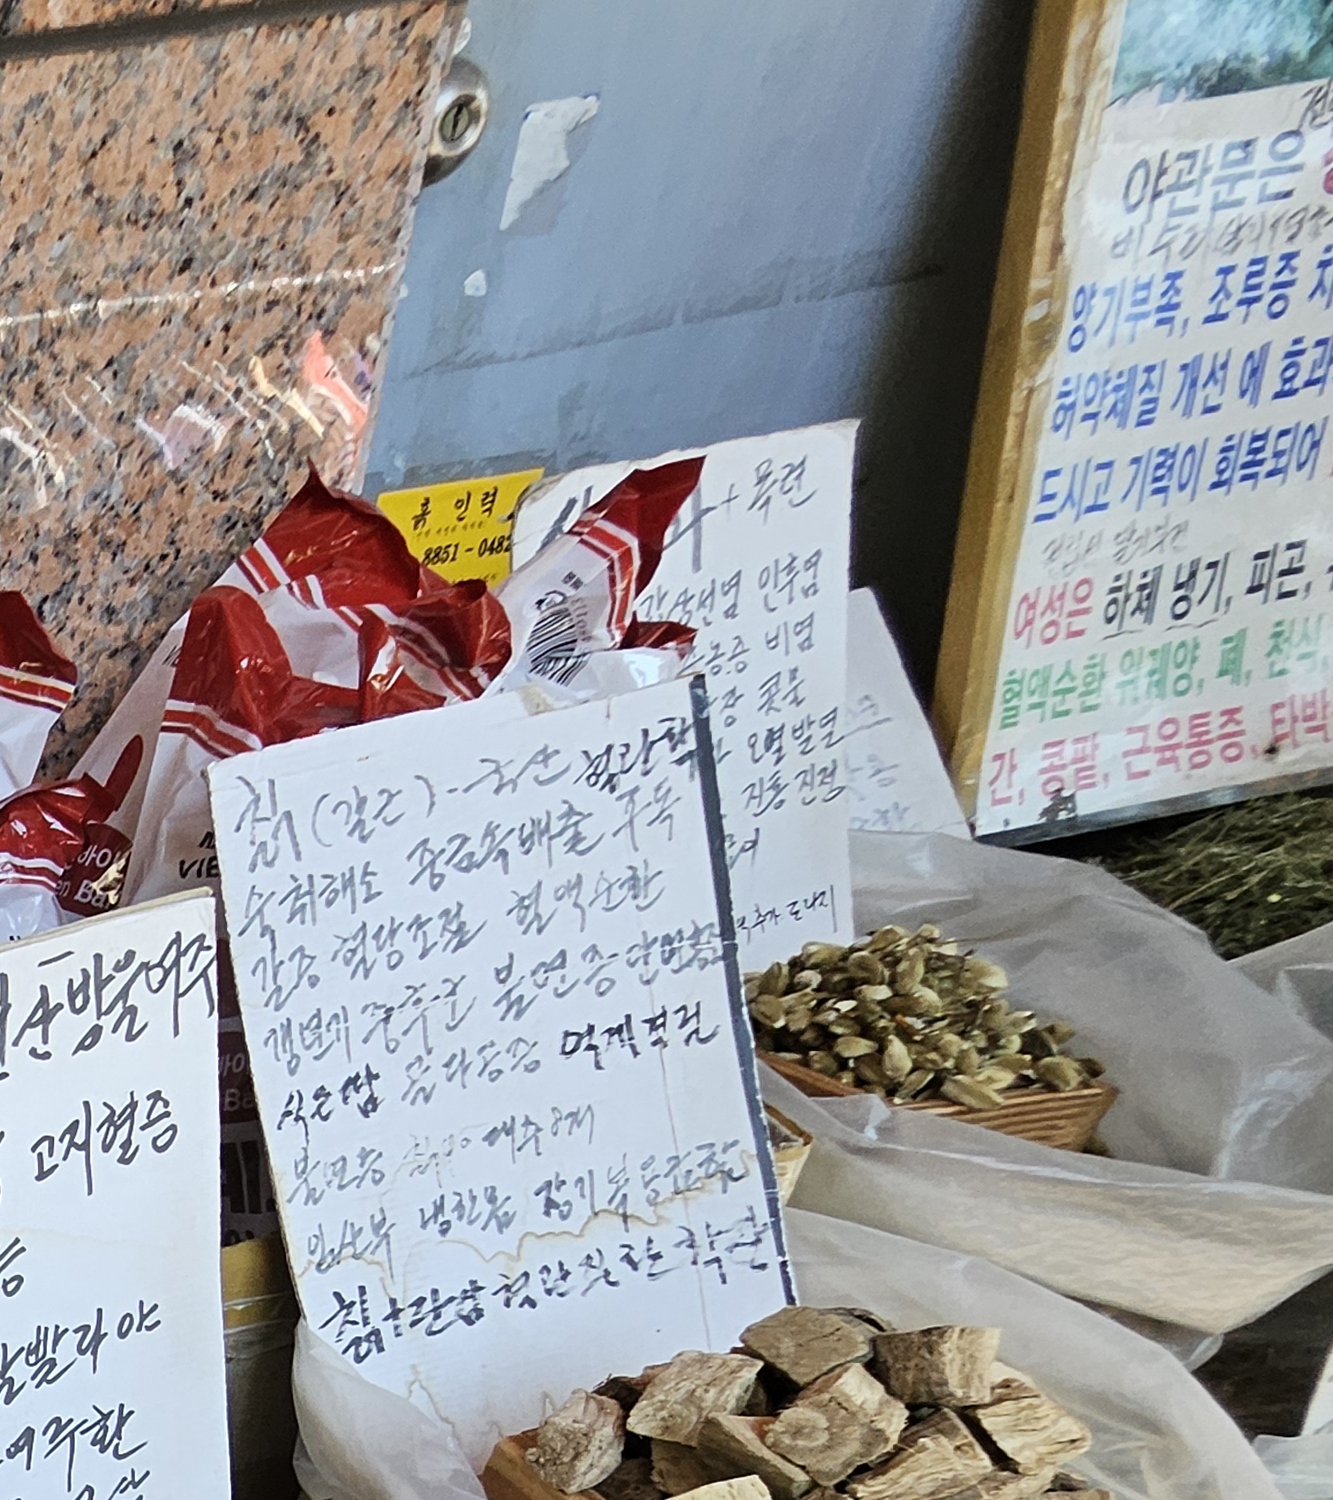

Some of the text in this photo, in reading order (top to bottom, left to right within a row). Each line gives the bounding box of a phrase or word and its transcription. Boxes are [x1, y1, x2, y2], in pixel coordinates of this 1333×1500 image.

[1202, 250, 1301, 325] 조루증
[1050, 359, 1167, 442] 허약체질
[1032, 416, 1329, 523] 드시고 기력이 회복되어
[1013, 575, 1095, 649] 여성은
[1102, 563, 1163, 632] 하체
[997, 651, 1107, 731] 혈액순환
